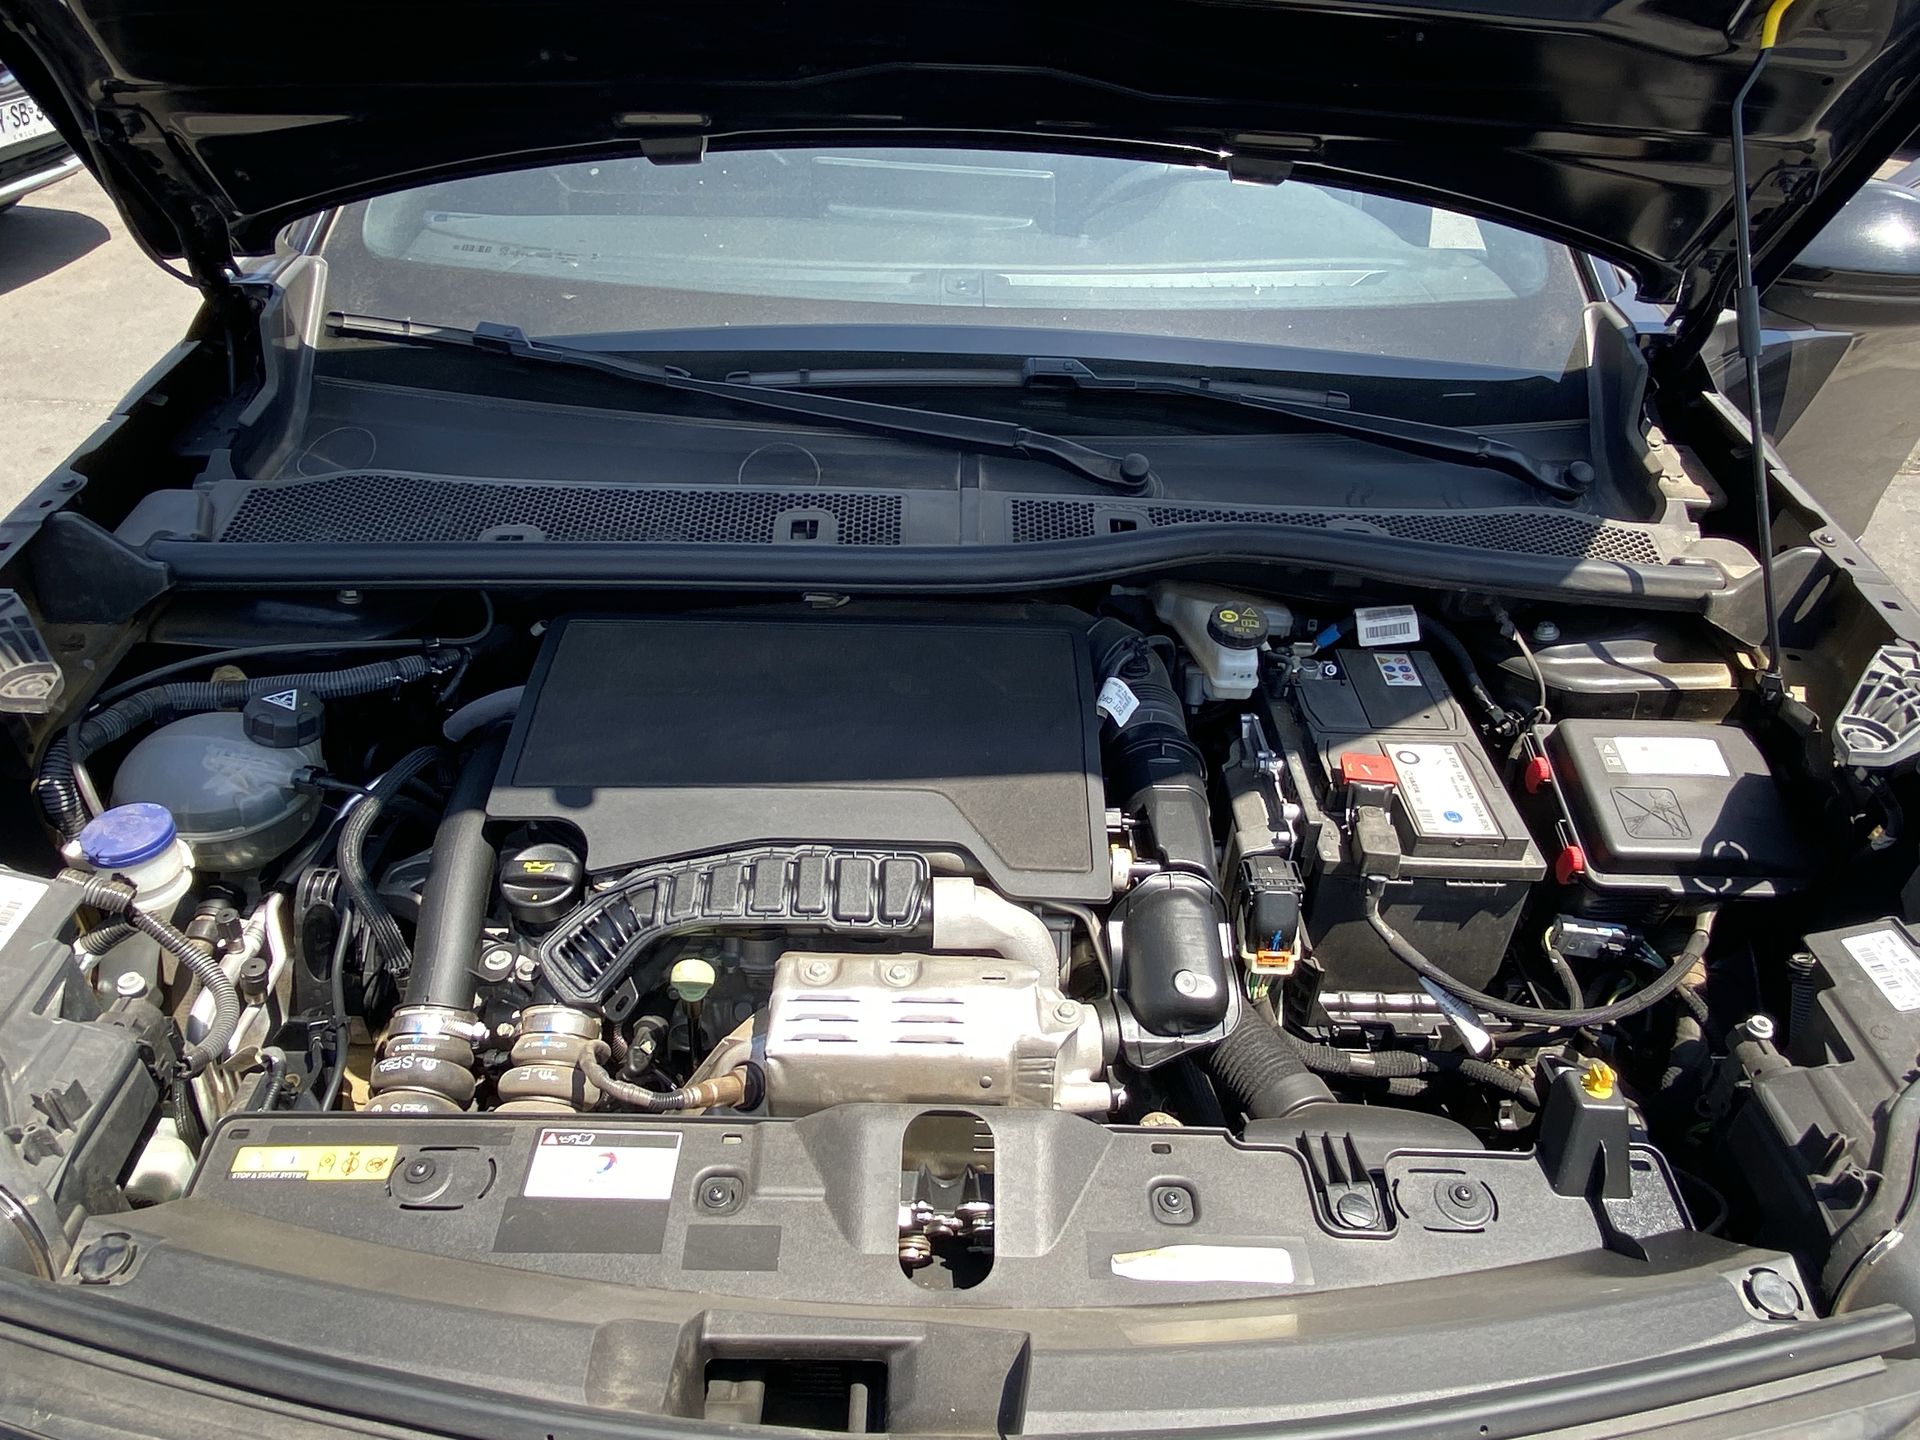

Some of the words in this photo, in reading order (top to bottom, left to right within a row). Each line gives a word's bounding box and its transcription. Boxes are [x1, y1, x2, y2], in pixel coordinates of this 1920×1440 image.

[232, 1171, 252, 1179] STOP
[257, 1171, 280, 1179] START
[279, 1171, 307, 1179] SYSTEM
